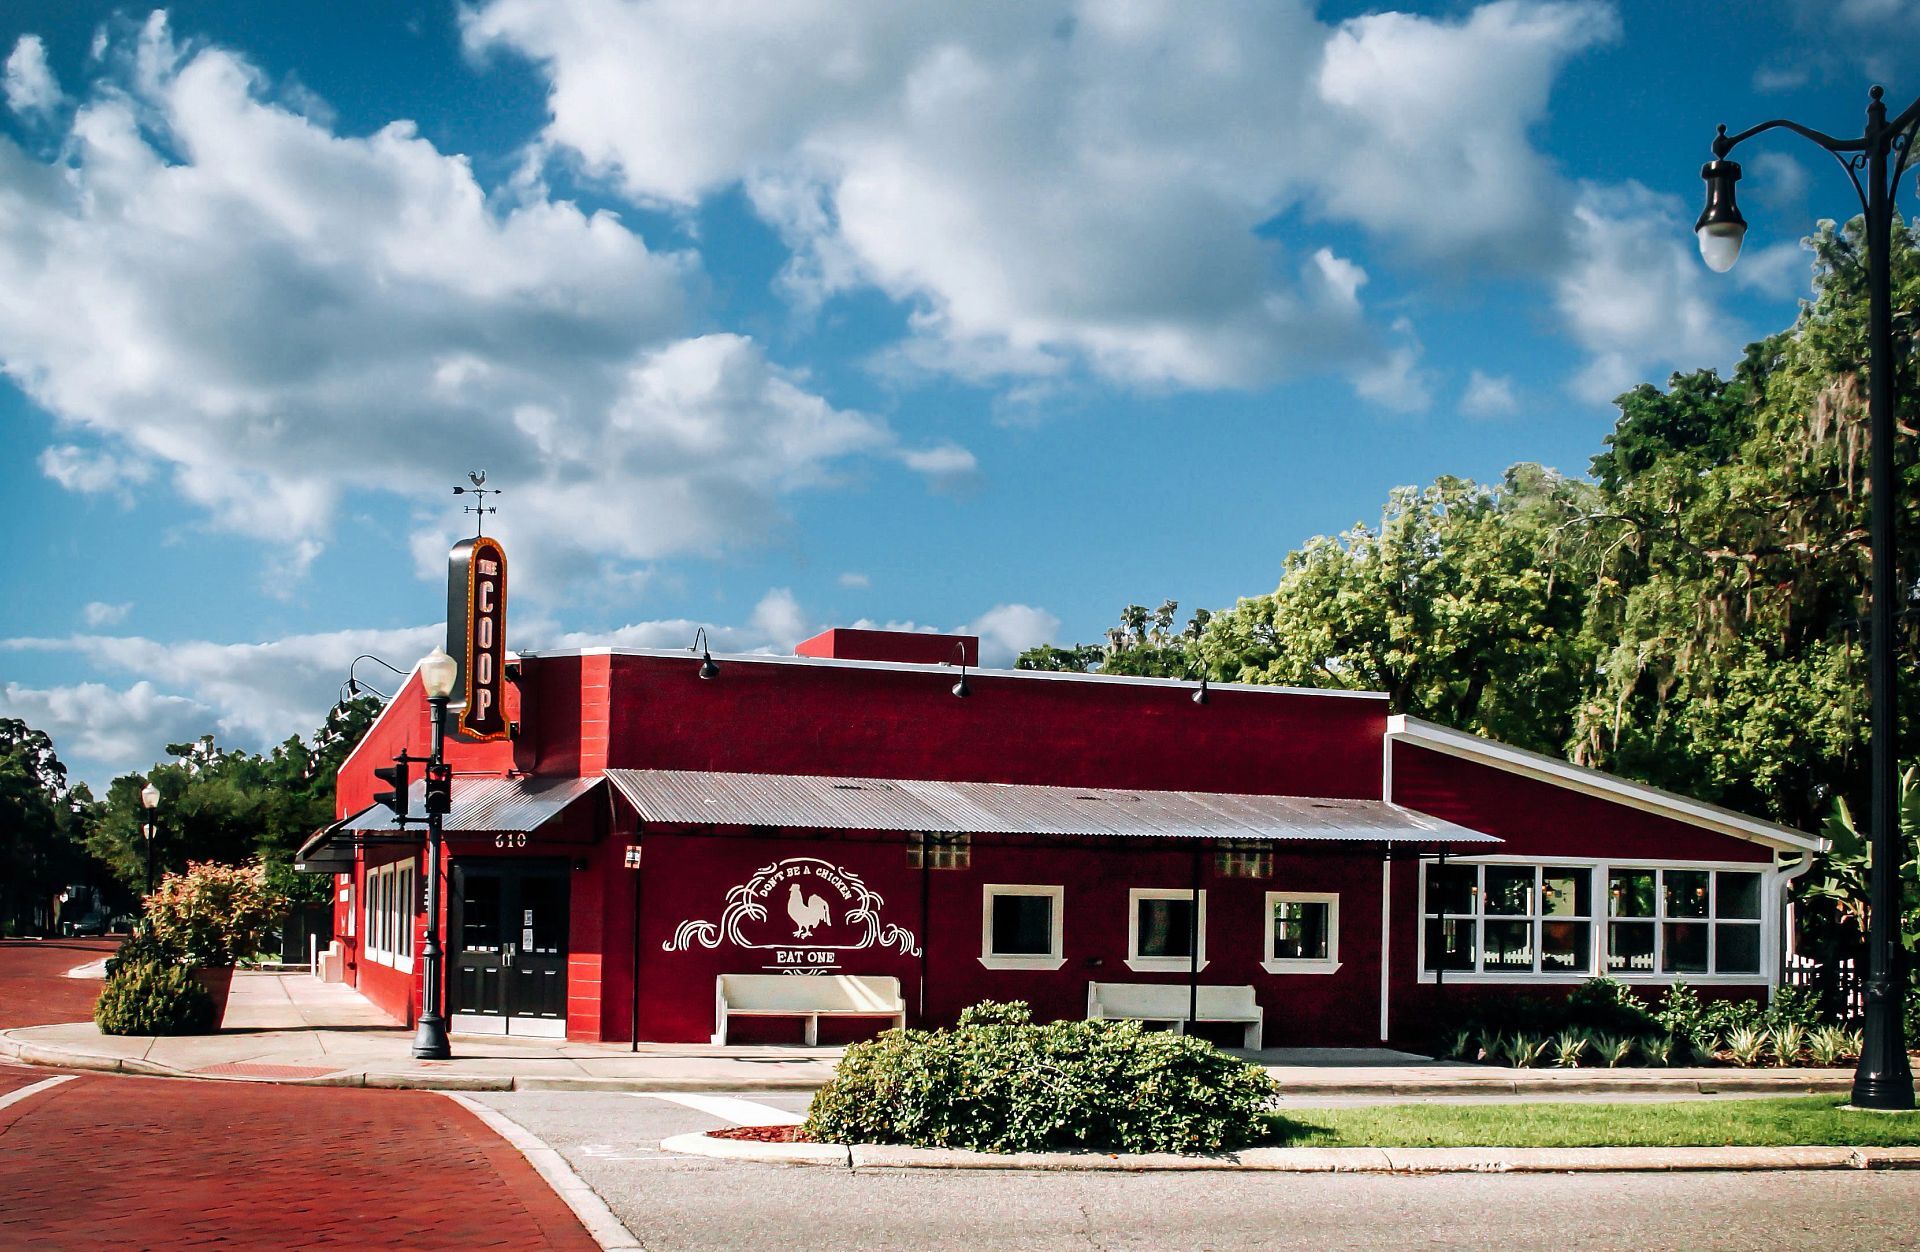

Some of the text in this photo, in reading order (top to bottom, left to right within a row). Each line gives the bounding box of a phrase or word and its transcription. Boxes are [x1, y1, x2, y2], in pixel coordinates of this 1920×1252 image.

[477, 559, 498, 576] THE
[476, 581, 494, 720] COOP
[495, 833, 527, 848] 610
[760, 866, 852, 900] DON'T BE A CHICKEN
[776, 951, 835, 963] EAT ONE
